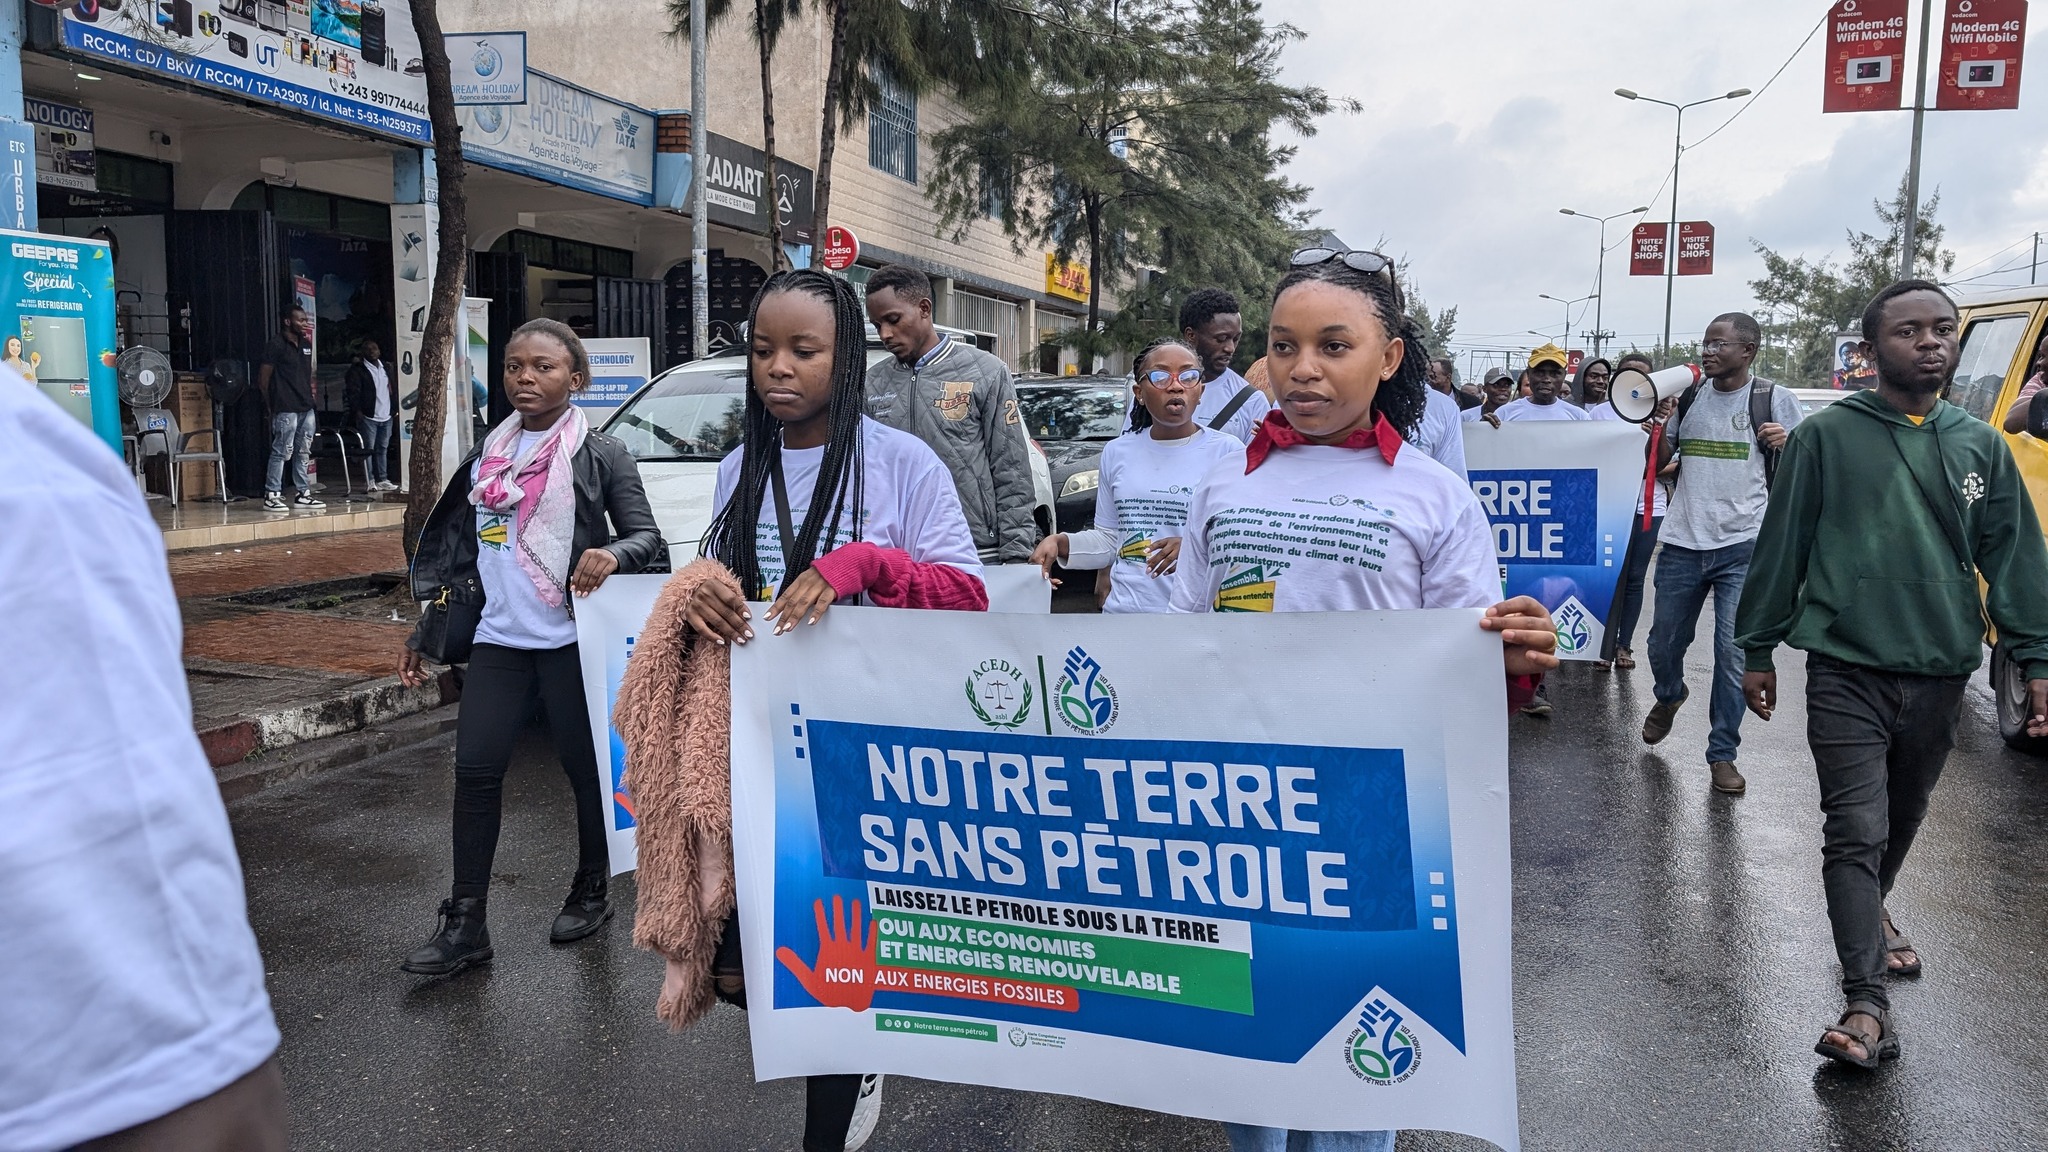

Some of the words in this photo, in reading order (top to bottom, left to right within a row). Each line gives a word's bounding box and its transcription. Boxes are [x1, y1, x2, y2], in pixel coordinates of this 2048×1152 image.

[1836, 18, 1884, 32] Modem
[1886, 16, 1904, 28] 4G
[1951, 21, 1999, 33] Modem
[2002, 20, 2020, 32] 4G
[1836, 31, 1859, 43] Wifi
[1861, 29, 1902, 41] Mobile
[1950, 33, 1973, 44] Wifi
[1975, 32, 2018, 43] Mobile
[83, 33, 131, 59] RCCM:
[135, 49, 162, 68] CD/
[167, 57, 202, 79] BKV/
[205, 67, 244, 89] RCCM
[256, 81, 309, 106] 17-A2903
[319, 98, 332, 112] Id.
[335, 103, 355, 119] Nat:
[357, 109, 422, 135] 5-93-N259375
[482, 84, 520, 94] HOLIDAY
[341, 82, 368, 100] +243
[370, 89, 426, 116] 991774444
[539, 78, 595, 121] DREAM
[26, 101, 92, 130] NOLOGY
[530, 104, 602, 149] HOLIDAY
[9, 140, 25, 153] ETS
[616, 131, 636, 150] IATA
[529, 143, 558, 164] Agence
[560, 153, 570, 165] de
[571, 154, 598, 173] Voyage
[1640, 244, 1658, 252] NOS
[1682, 235, 1710, 243] VISITEZ
[1686, 242, 1705, 250] NOS
[12, 243, 78, 263] GEEPAS
[1634, 251, 1663, 260] SHOPS
[1680, 249, 1710, 258] SHOPS
[23, 271, 75, 292] Special
[37, 300, 84, 311] REFRIGERATOR
[149, 419, 166, 428] CLASS
[1239, 506, 1296, 519] protégeons
[1299, 512, 1310, 520] et
[1312, 515, 1355, 525] rendons
[1357, 518, 1391, 534] justice
[1269, 520, 1282, 528] de
[1288, 521, 1373, 542] l'environnement
[1378, 538, 1389, 547] et
[1243, 529, 1307, 544] autochtones
[1310, 536, 1336, 547] dans
[1339, 539, 1360, 551] leur
[1363, 544, 1386, 560] lutte
[1223, 541, 1283, 555] préservation
[1288, 547, 1301, 556] du
[1305, 549, 1339, 562] climat
[1343, 556, 1355, 565] et
[1358, 558, 1382, 573] leurs
[1233, 555, 1291, 569] subsistance
[1220, 572, 1260, 590] Ensemble,
[1242, 591, 1274, 601] entendre
[972, 658, 1023, 682] ACEDH
[1054, 674, 1068, 693] NOTRE
[1053, 693, 1061, 712] TERRE
[1107, 682, 1120, 711] WITHOUT
[995, 713, 1008, 721] asbl
[1057, 711, 1072, 728] SANS
[1109, 710, 1119, 727] LAND
[1098, 724, 1111, 735] OUR
[867, 743, 1072, 817] NOTRE
[1083, 757, 1320, 835] TERRE
[860, 813, 1026, 886] SANS
[874, 887, 948, 912] LAISSEZ
[951, 895, 973, 915] LE
[976, 898, 1059, 926] PETROLE
[1063, 908, 1118, 932] SOUS
[1122, 913, 1148, 936] LA
[1151, 917, 1220, 944] TERRE
[879, 917, 914, 938] OUI
[919, 921, 963, 944] AUX
[966, 928, 1096, 960] ECONOMIES
[880, 940, 903, 959] ET
[907, 943, 1005, 971] ENERGIES
[1008, 954, 1181, 995] RENOUVELABLE
[825, 967, 863, 984] NON
[874, 970, 909, 987] AUX
[913, 973, 989, 996] ENERGIES
[994, 982, 1065, 1006] FOSSILES
[914, 1022, 932, 1030] Notre
[933, 1023, 948, 1031] terre
[949, 1026, 964, 1034] sans
[965, 1026, 989, 1037] pétrole
[1345, 1027, 1361, 1045] NOTRE
[1344, 1045, 1352, 1064] TERRE
[1408, 1033, 1422, 1060] WITHOUT
[1348, 1063, 1364, 1079] SANS
[1409, 1060, 1421, 1076] LAND
[1362, 1075, 1392, 1086] PÉTROLE
[1396, 1073, 1410, 1083] OUR
